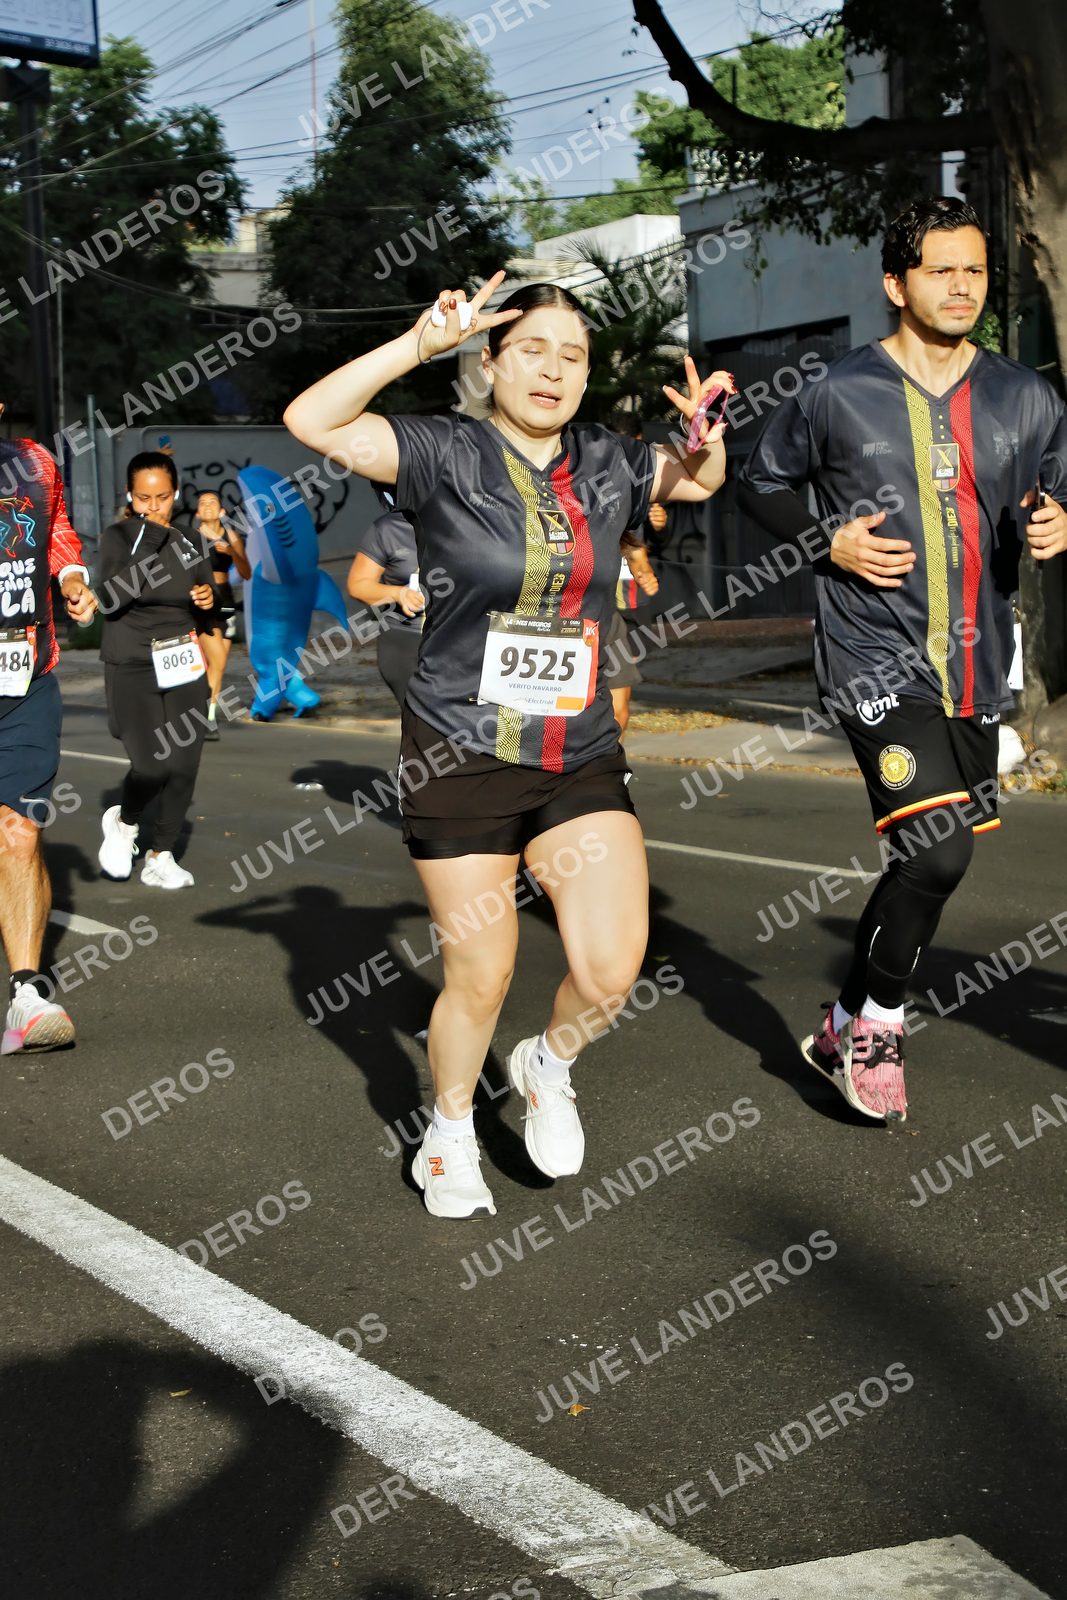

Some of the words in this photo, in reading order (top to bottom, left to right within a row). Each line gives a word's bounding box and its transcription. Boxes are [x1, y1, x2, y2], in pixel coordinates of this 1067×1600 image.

[163, 649, 195, 670] 8063
[500, 646, 577, 681] 9525
[533, 684, 562, 692] NAVARRO
